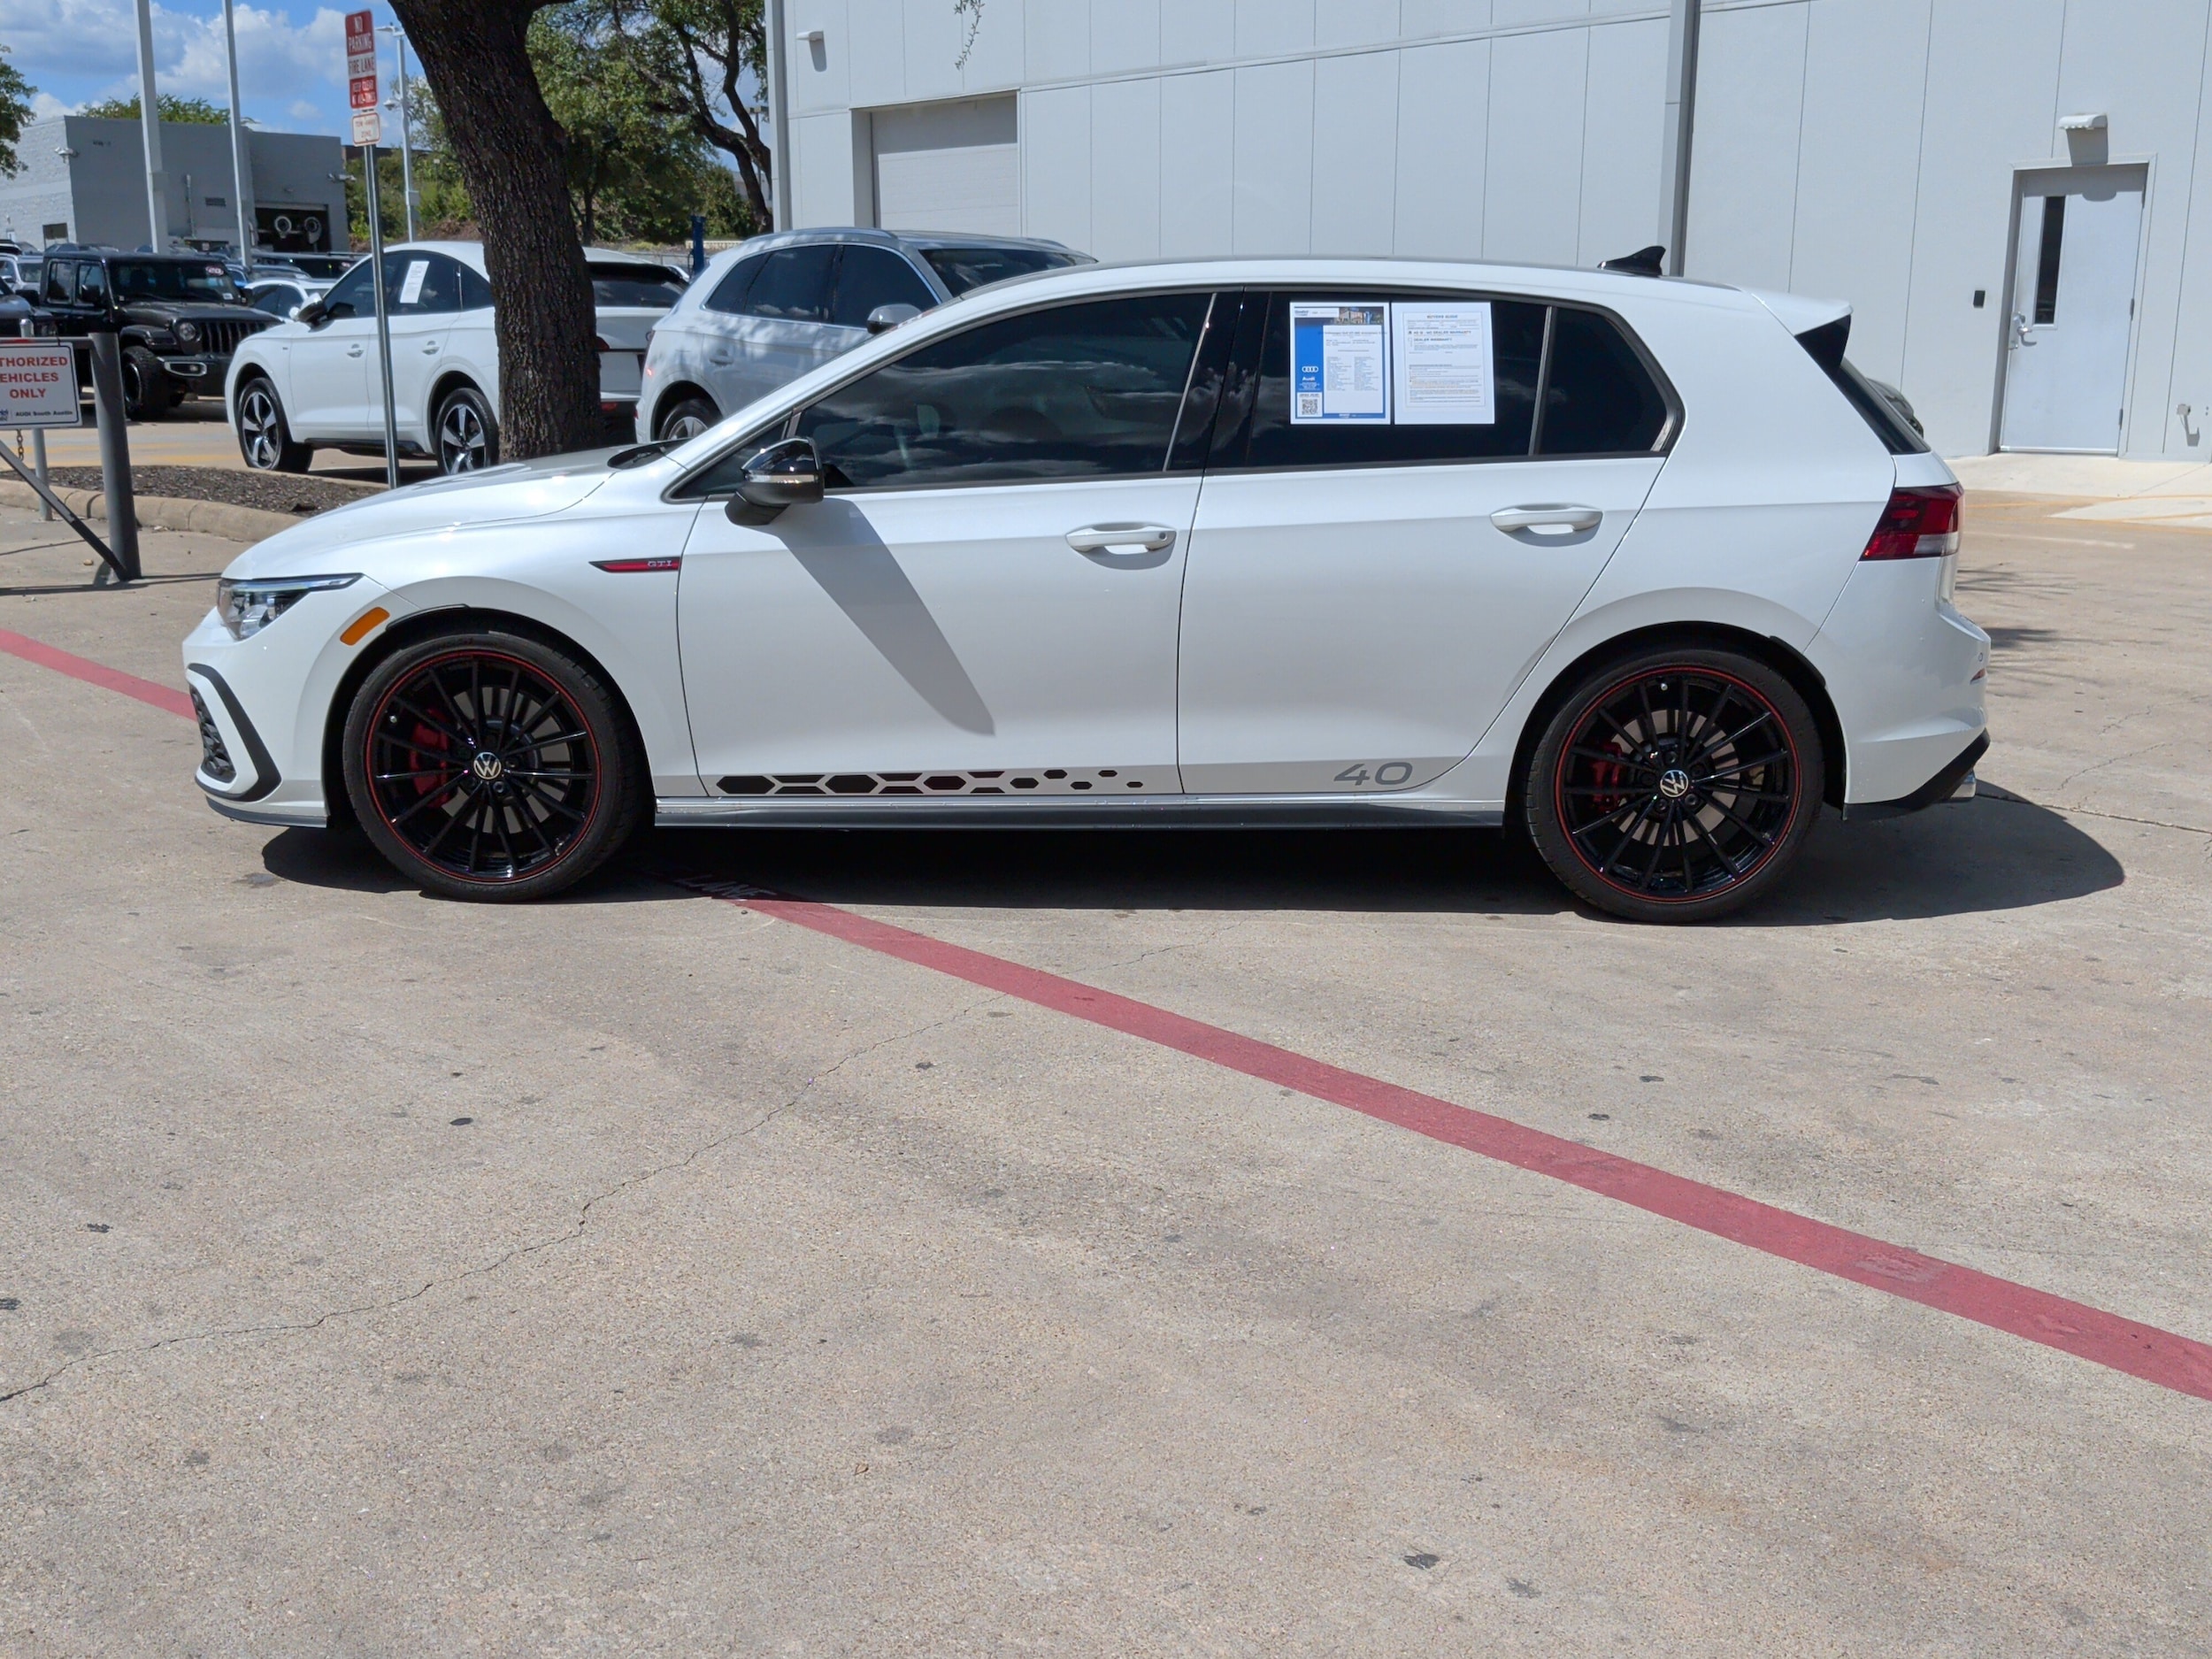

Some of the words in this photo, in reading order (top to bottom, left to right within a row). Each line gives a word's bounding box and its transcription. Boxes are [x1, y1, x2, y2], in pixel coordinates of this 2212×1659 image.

[354, 16, 364, 33] NO
[349, 32, 372, 53] PARKING
[349, 59, 360, 74] FIRE
[361, 57, 376, 72] LANE
[10, 388, 46, 399] ONLY
[1333, 762, 1413, 786] 40
